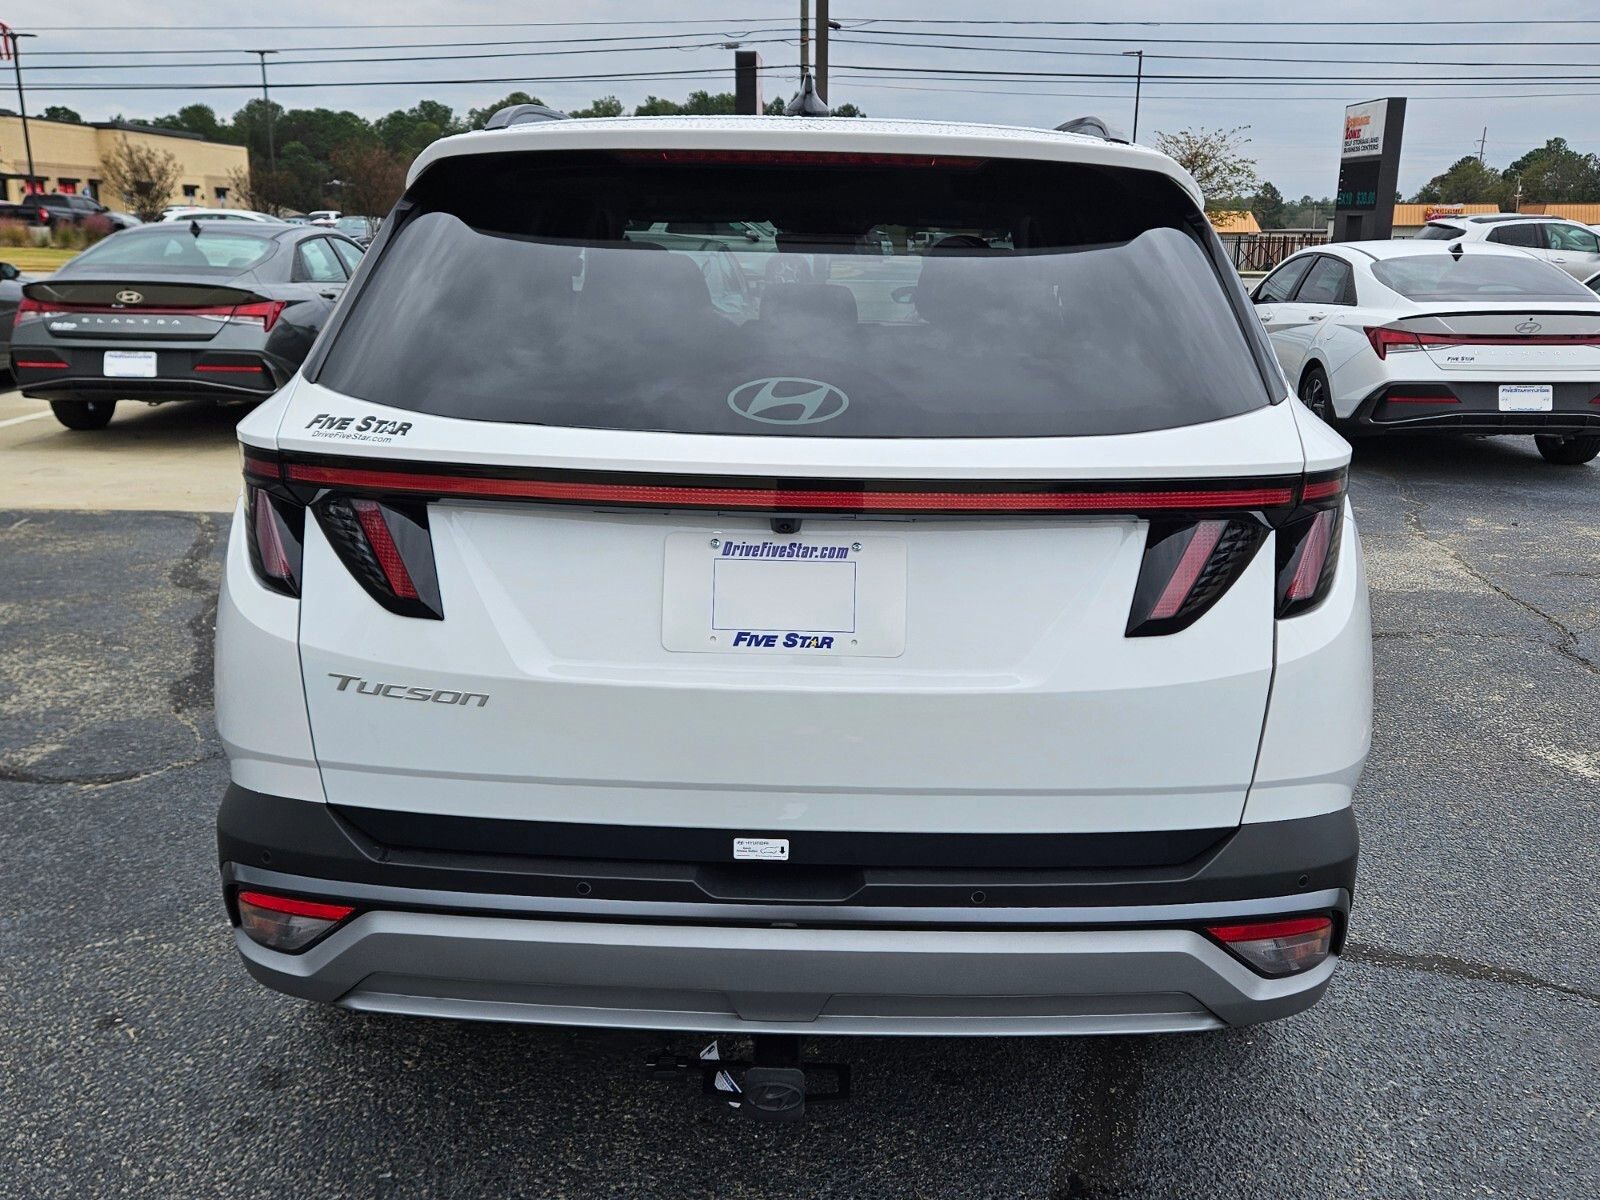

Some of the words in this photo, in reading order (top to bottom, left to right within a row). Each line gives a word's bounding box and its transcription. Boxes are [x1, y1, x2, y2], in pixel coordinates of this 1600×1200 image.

[1361, 144, 1379, 152] CENTERS
[305, 413, 355, 431] FIVE
[355, 415, 413, 436] STAR
[311, 430, 392, 443] DriveFiveStar.com
[721, 541, 849, 559] DriveFiveStar.com
[732, 631, 778, 648] FIVE
[782, 632, 834, 649] STAR
